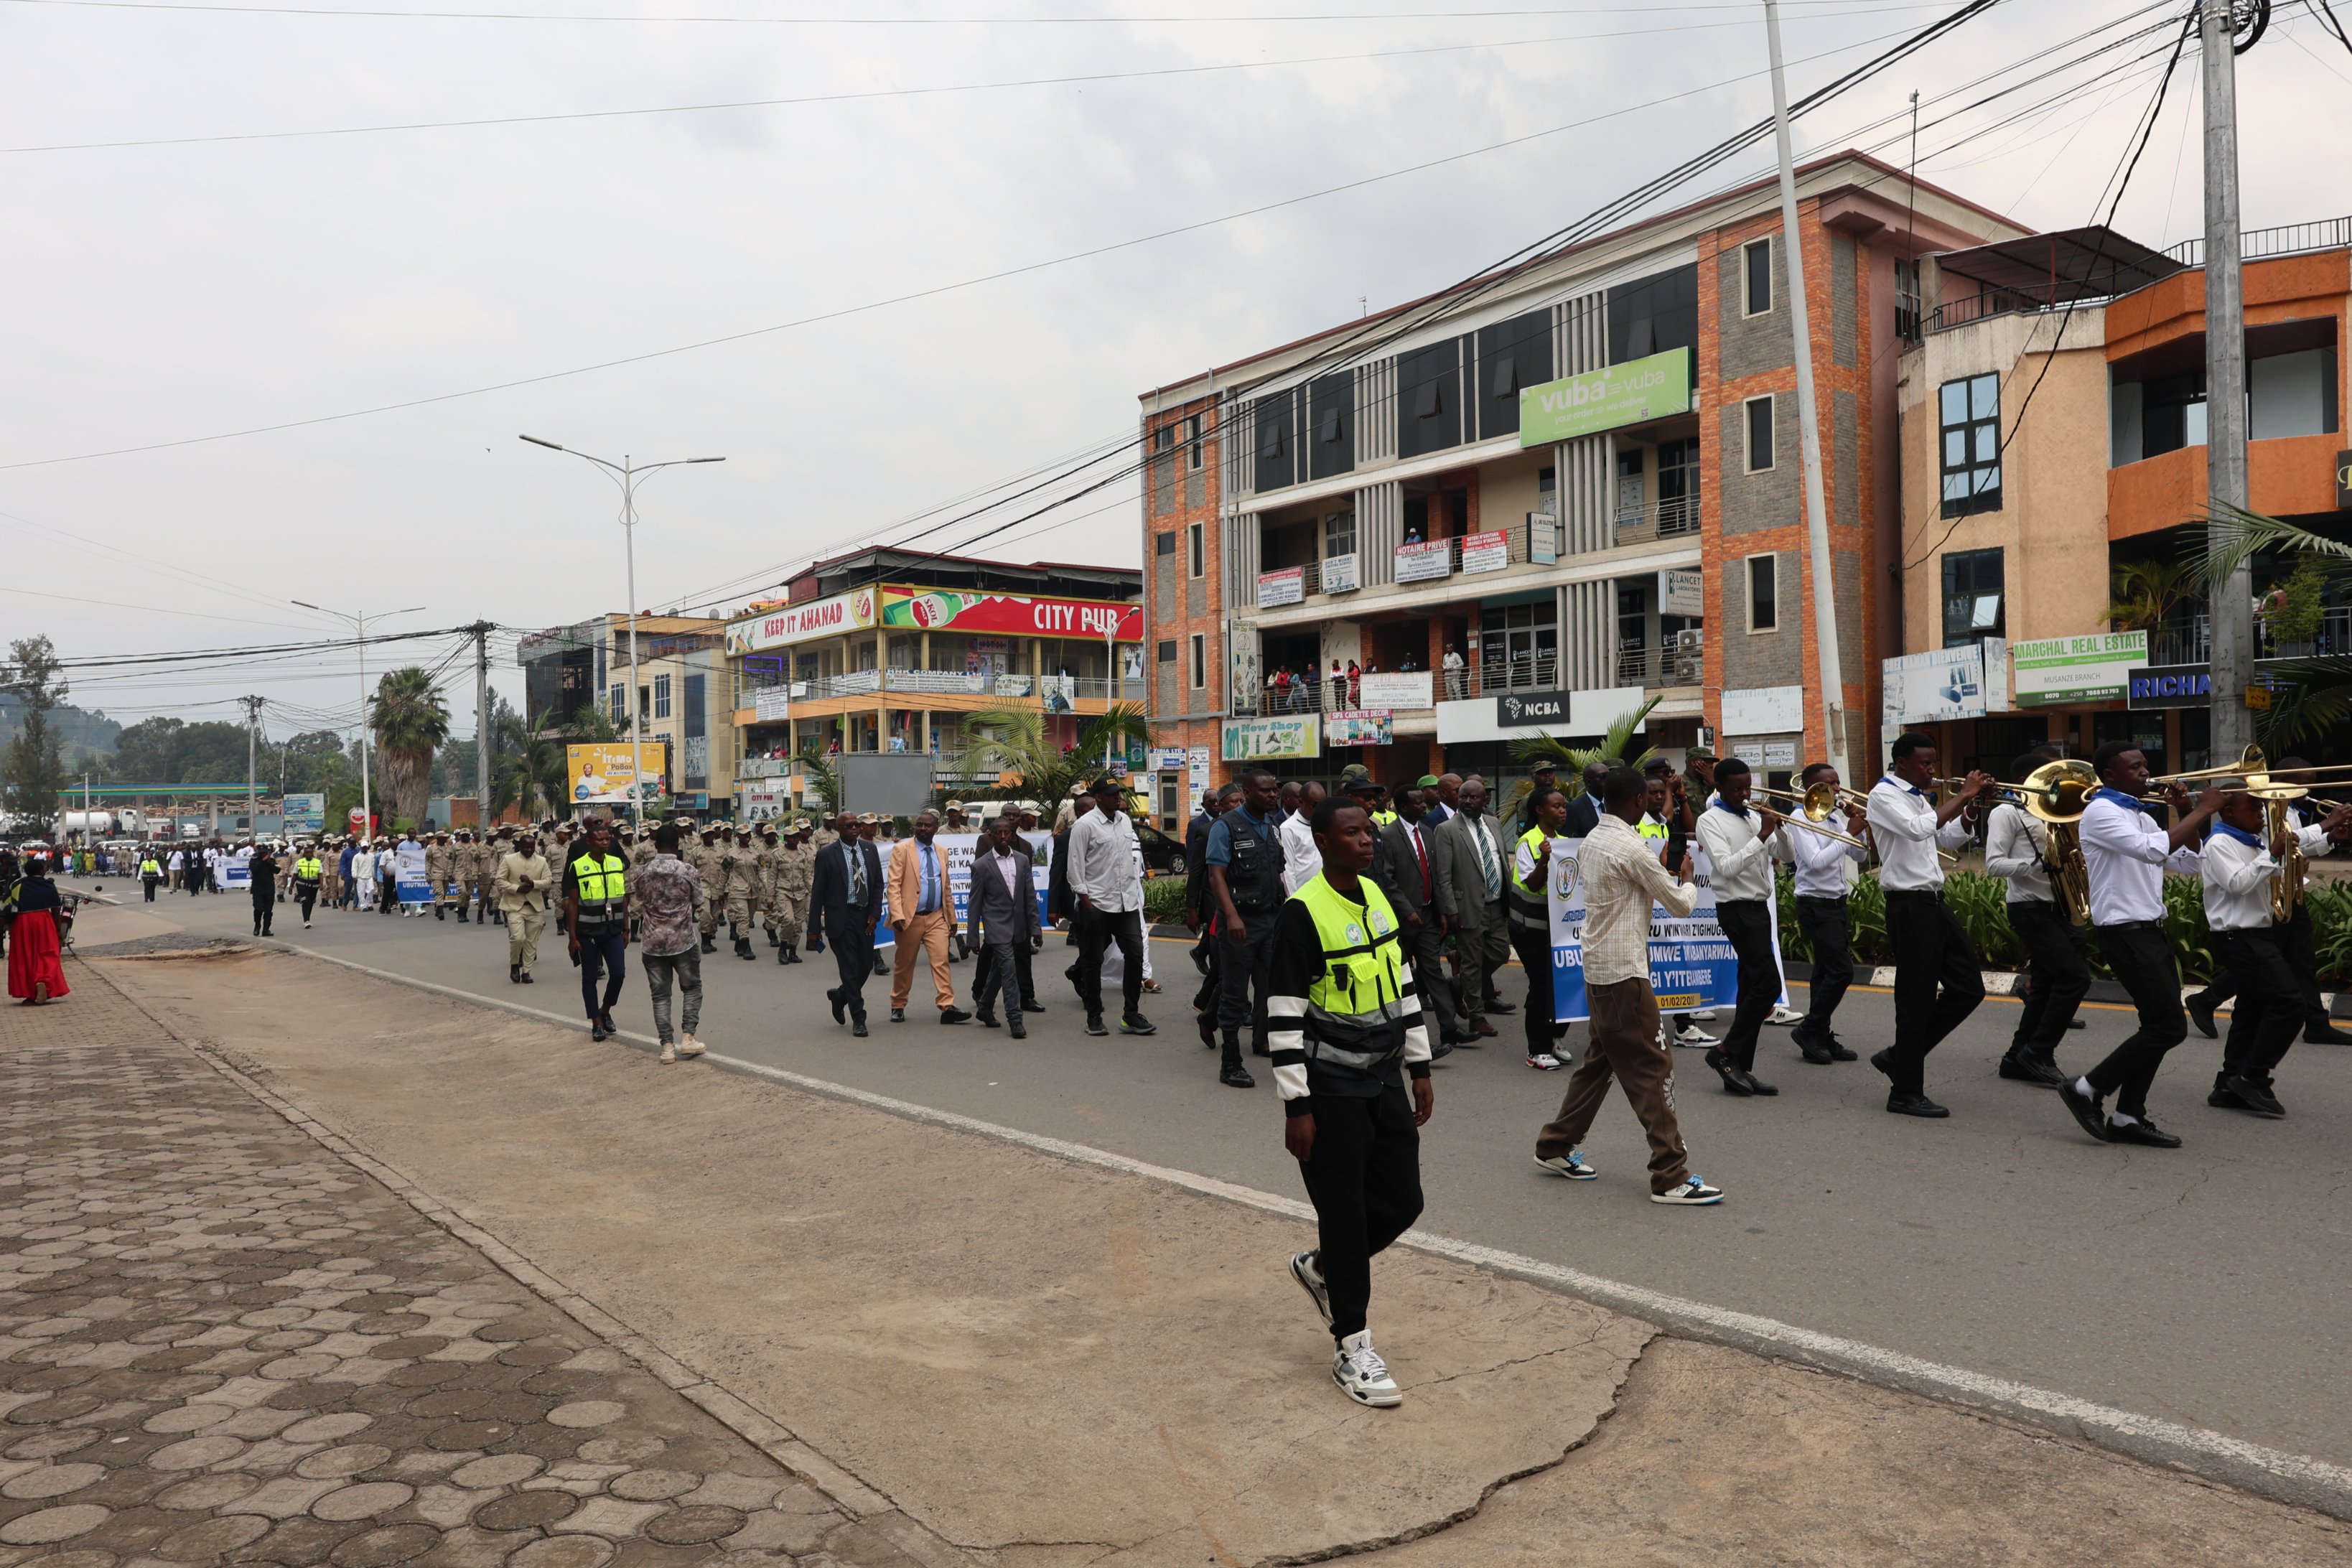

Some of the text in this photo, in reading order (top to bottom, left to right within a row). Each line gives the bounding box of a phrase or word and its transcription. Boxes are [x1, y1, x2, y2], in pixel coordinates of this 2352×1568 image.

[1540, 370, 1666, 413] vuba vuba
[1555, 396, 1647, 425] your order we deliver
[1397, 539, 1447, 556] NOTAIRE PRIVE
[1676, 574, 1701, 585] LANCET
[920, 606, 928, 621] MALT
[924, 598, 939, 623] SKOL
[1034, 604, 1118, 633] CITY PUB
[765, 602, 842, 638] KEEP IT AHANAD
[2015, 633, 2146, 659] MARCHAL REAL ESTATE
[844, 671, 869, 679] COMPANY
[1362, 675, 1381, 683] AVOCAT
[1383, 674, 1388, 683] ET
[2044, 672, 2101, 684] MUSANZE BRANCH
[1525, 701, 1560, 716] NCBA
[1241, 721, 1302, 733] New Shop
